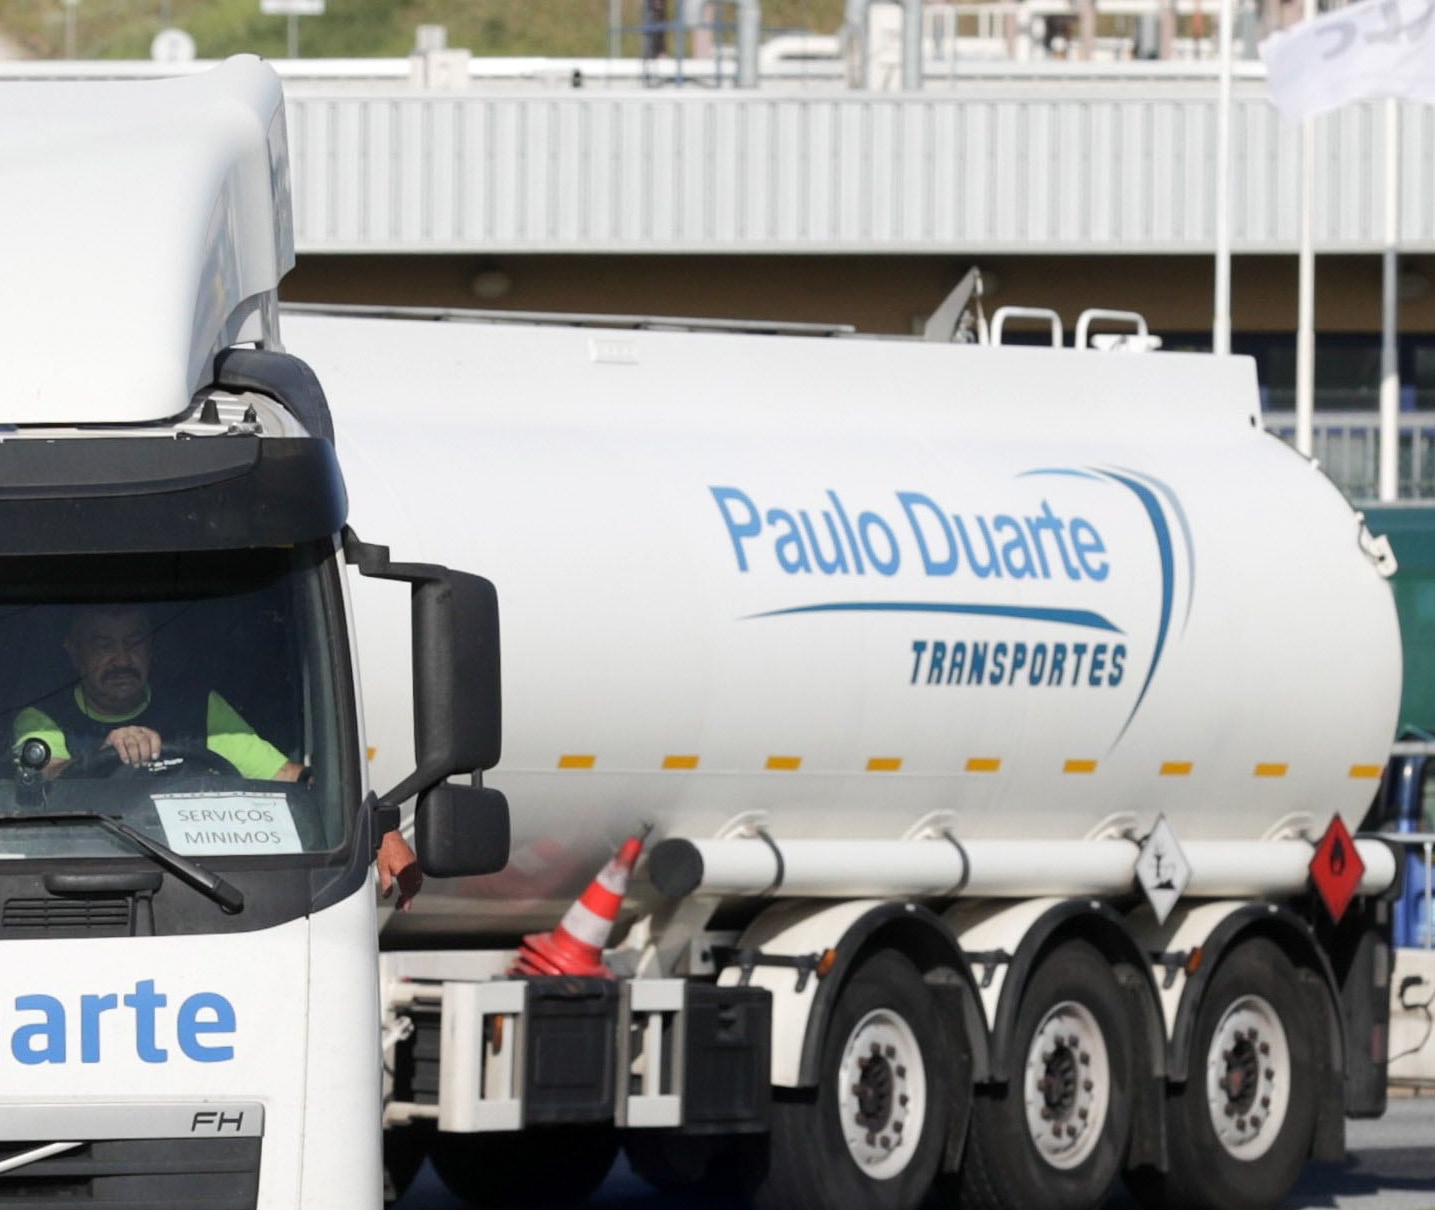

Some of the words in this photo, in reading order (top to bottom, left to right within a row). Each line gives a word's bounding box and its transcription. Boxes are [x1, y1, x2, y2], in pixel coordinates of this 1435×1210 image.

[708, 485, 902, 577] Paulo
[894, 490, 1110, 582] Duarte
[909, 640, 1127, 687] TRANSPORTES
[177, 809, 274, 824] SERVIÇOS
[190, 1110, 246, 1133] FH
